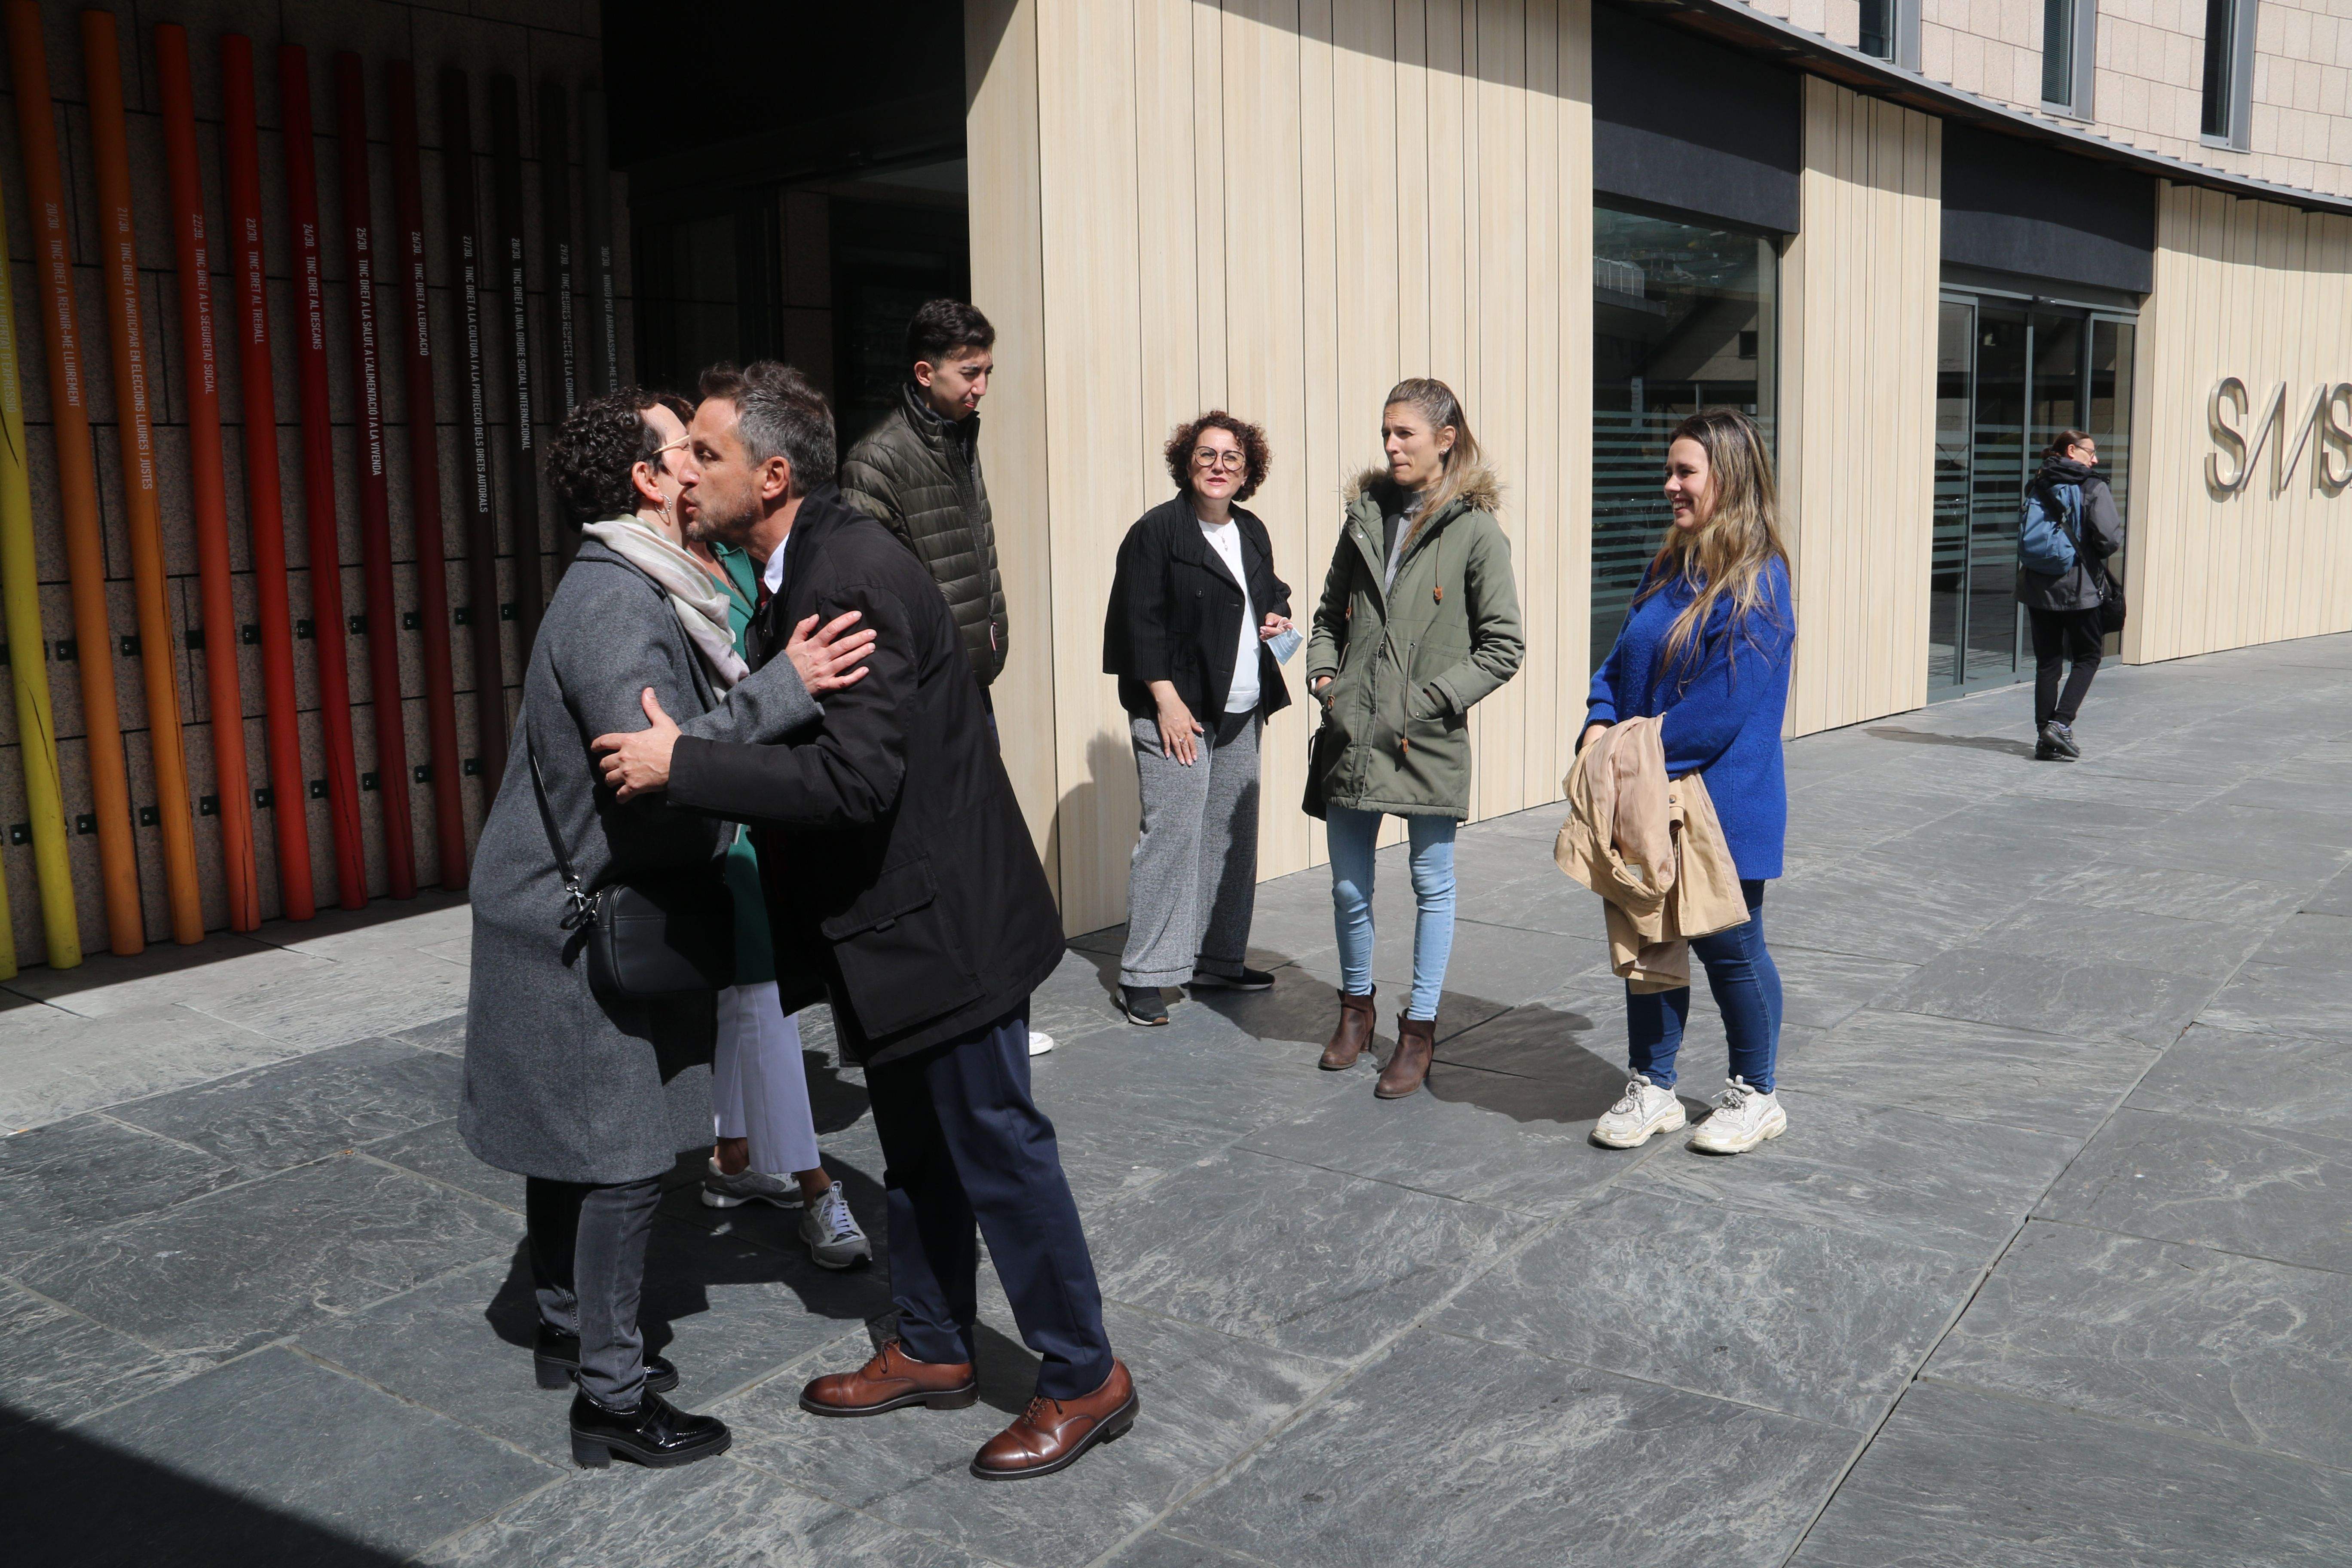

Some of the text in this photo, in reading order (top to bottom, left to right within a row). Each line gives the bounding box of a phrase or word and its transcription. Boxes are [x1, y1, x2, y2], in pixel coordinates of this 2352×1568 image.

[45, 202, 60, 230] 20/30.
[117, 207, 129, 234] 21/30.
[193, 214, 204, 240] 22/30.
[50, 239, 64, 260] TINC
[356, 227, 367, 252] 25/30.
[411, 232, 422, 255] 26/30.
[463, 236, 473, 259] 27/30.
[511, 238, 521, 261] 28/30.
[120, 242, 132, 262] TINC
[196, 248, 205, 267] TINC
[560, 244, 569, 267] 29/30.
[601, 246, 610, 269] 30/30.
[53, 262, 67, 285] DRET
[122, 264, 134, 287] DRET
[358, 259, 369, 277] TINC
[414, 263, 423, 280] TINC
[465, 266, 474, 283] TINC
[513, 268, 522, 284] TINC
[196, 270, 208, 291] DRET
[246, 218, 264, 344] 23/30. TINC DRET AL TREBALL
[303, 224, 322, 349] 24/30. TINC DRET AL DESCANS
[360, 279, 370, 300] DRET
[416, 282, 425, 302] DRET
[561, 273, 570, 289] TINC
[466, 285, 475, 304] DRET
[514, 286, 523, 305] DRET
[604, 299, 613, 312] POT
[199, 302, 209, 312] LA
[361, 309, 371, 319] LA
[468, 313, 476, 323] LA
[57, 296, 74, 349] REUNIR-ME
[125, 297, 139, 347] PARTICIPAR
[417, 311, 429, 355] L'EDUCACIÓ
[515, 314, 524, 330] UNA
[200, 315, 213, 362] SEGURETAT
[468, 325, 478, 358] CULTURA
[516, 332, 526, 357] ORDRE
[606, 314, 617, 377] ARRABASSAR-ME
[130, 350, 141, 361] EN
[1, 353, 17, 413] D'EXPRESSIÓ
[63, 351, 80, 407] LLIUREMENT
[204, 364, 214, 395] SOCIAL
[471, 372, 480, 382] LA
[517, 359, 527, 386] SOCIAL
[564, 367, 573, 376] LA
[131, 364, 145, 412] ELECCIONS
[364, 358, 378, 415] L'ALIMENTACIÓ
[472, 383, 484, 425] PROTECCIÓ
[136, 414, 149, 450] LLIURES
[519, 392, 530, 450] INTERNACIONAL
[370, 430, 379, 440] LA
[474, 427, 484, 446] DELS
[371, 442, 381, 475] VIVENDA
[476, 448, 485, 472] DRETS
[140, 458, 153, 490] JUSTES
[477, 474, 488, 512] AUTORALS
